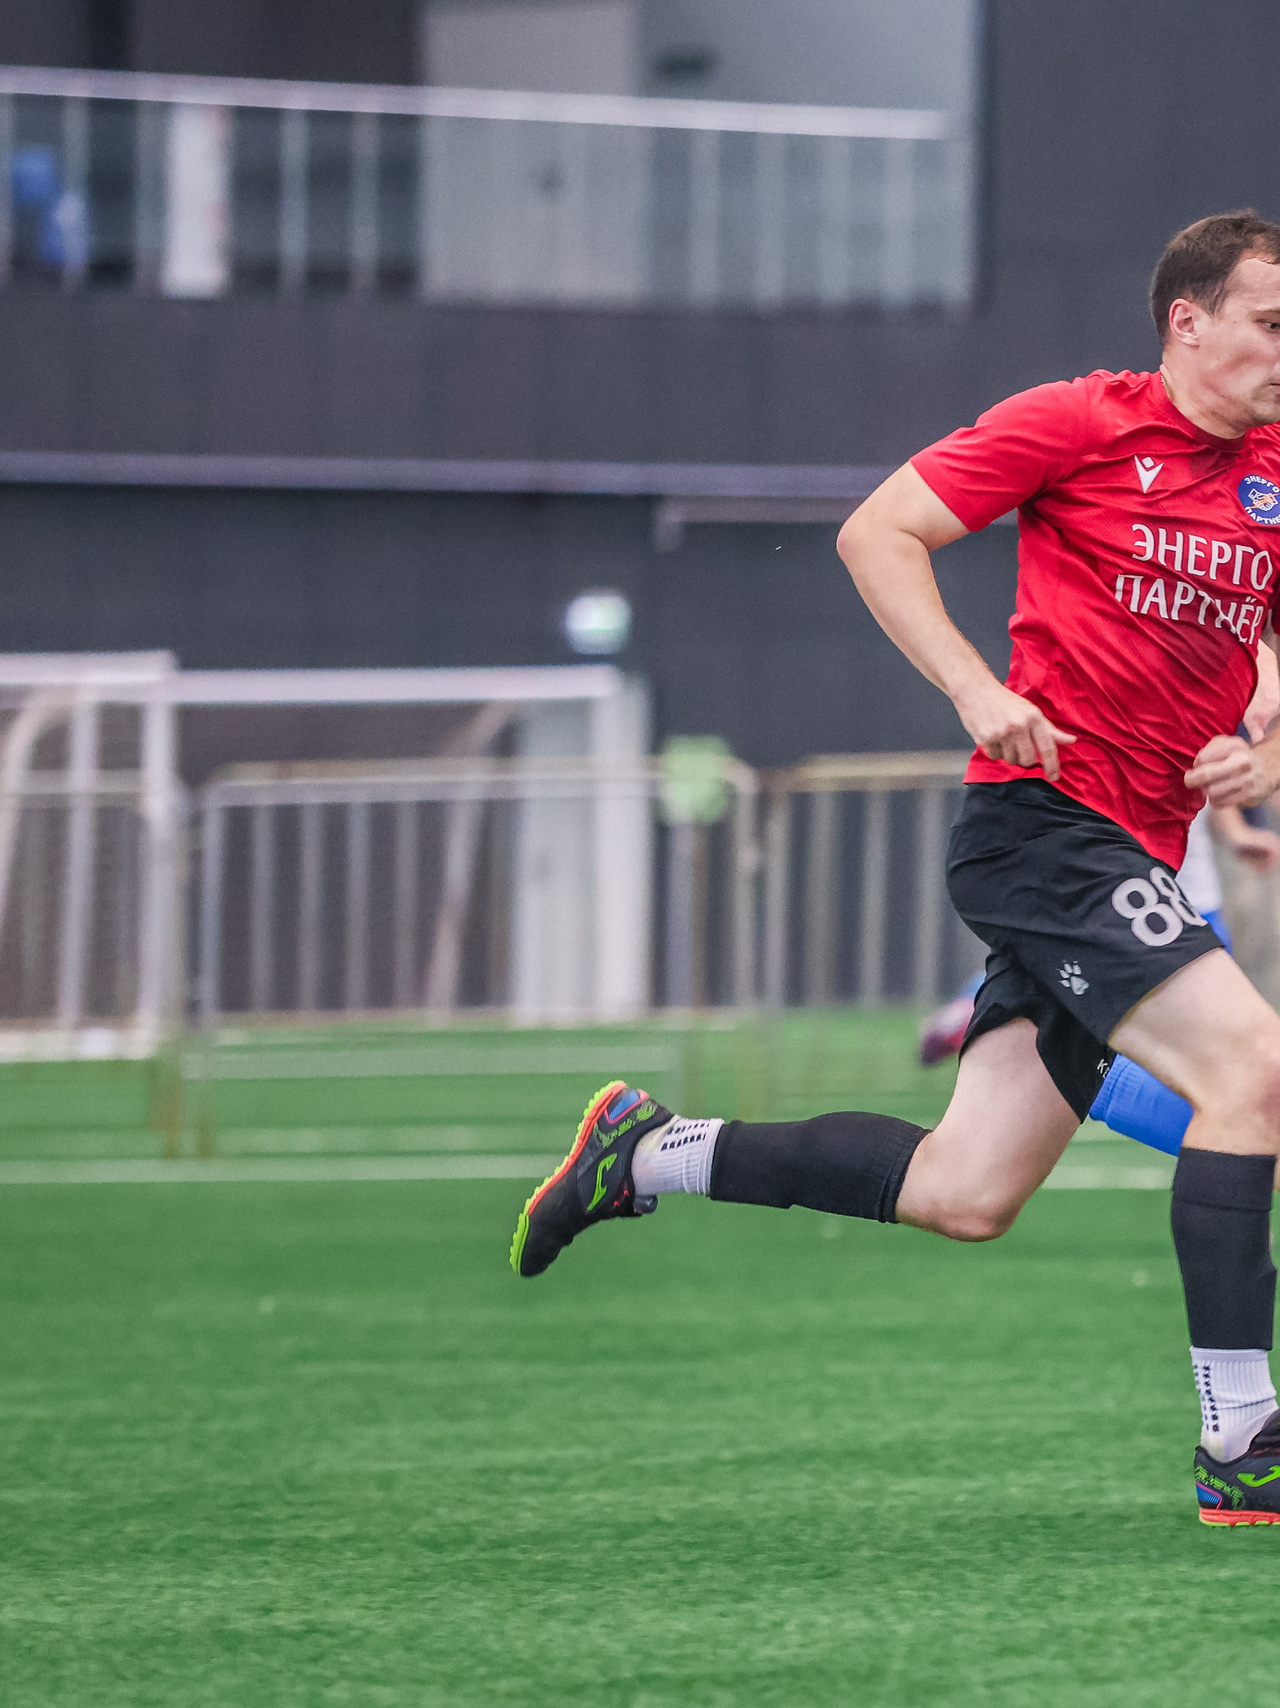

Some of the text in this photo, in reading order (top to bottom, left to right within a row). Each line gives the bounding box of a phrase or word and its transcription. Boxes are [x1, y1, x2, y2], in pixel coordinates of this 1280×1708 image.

[1244, 475, 1280, 493] ЭНЕРГО
[1131, 523, 1273, 591] ЭНЕРГО
[1115, 573, 1264, 645] ПАРТНЁР
[1112, 866, 1209, 947] 88
